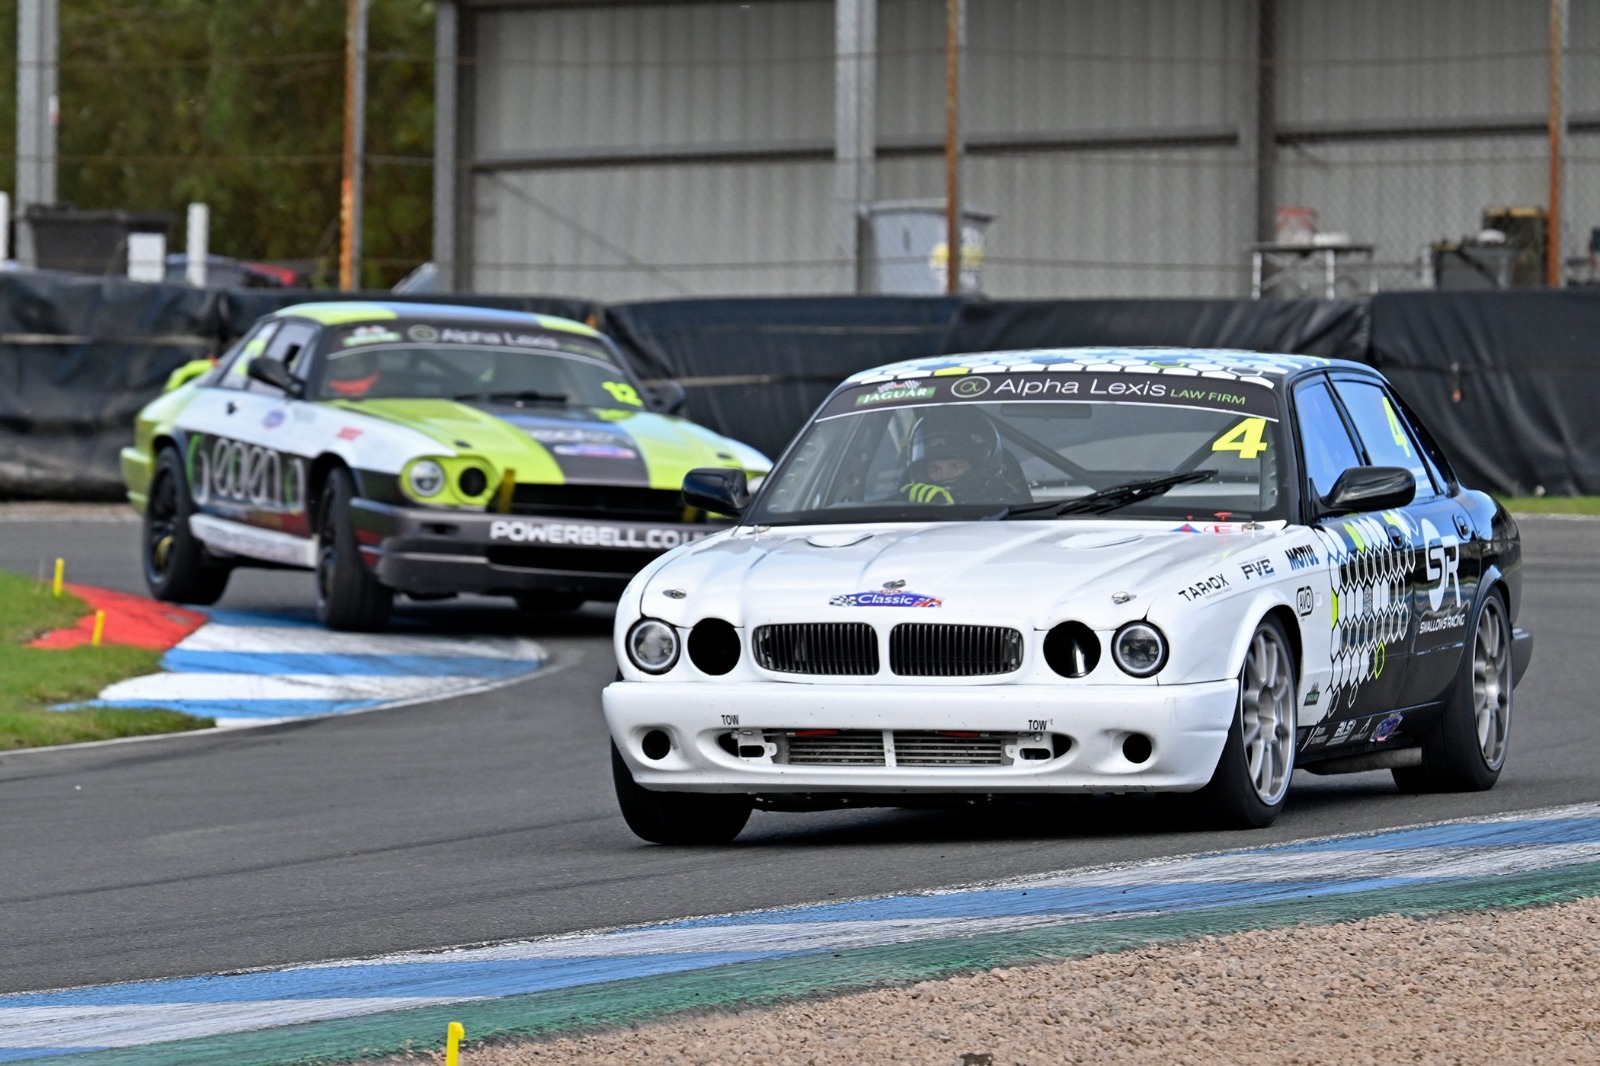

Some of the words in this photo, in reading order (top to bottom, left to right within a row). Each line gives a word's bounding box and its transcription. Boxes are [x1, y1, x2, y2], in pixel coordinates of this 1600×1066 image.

[863, 388, 928, 404] JAGUAR
[993, 376, 1079, 397] Alpha
[1090, 377, 1166, 397] Lexis
[1170, 387, 1206, 402] LAW
[1208, 391, 1246, 406] FIRM
[1382, 396, 1411, 458] 4
[1211, 417, 1268, 459] 4
[1284, 544, 1319, 571] MOTUL
[857, 593, 914, 605] Classic
[1419, 615, 1448, 634] SWALLOWS
[1446, 613, 1465, 630] RACING
[721, 714, 740, 726] TOW
[1028, 719, 1048, 731] TOW
